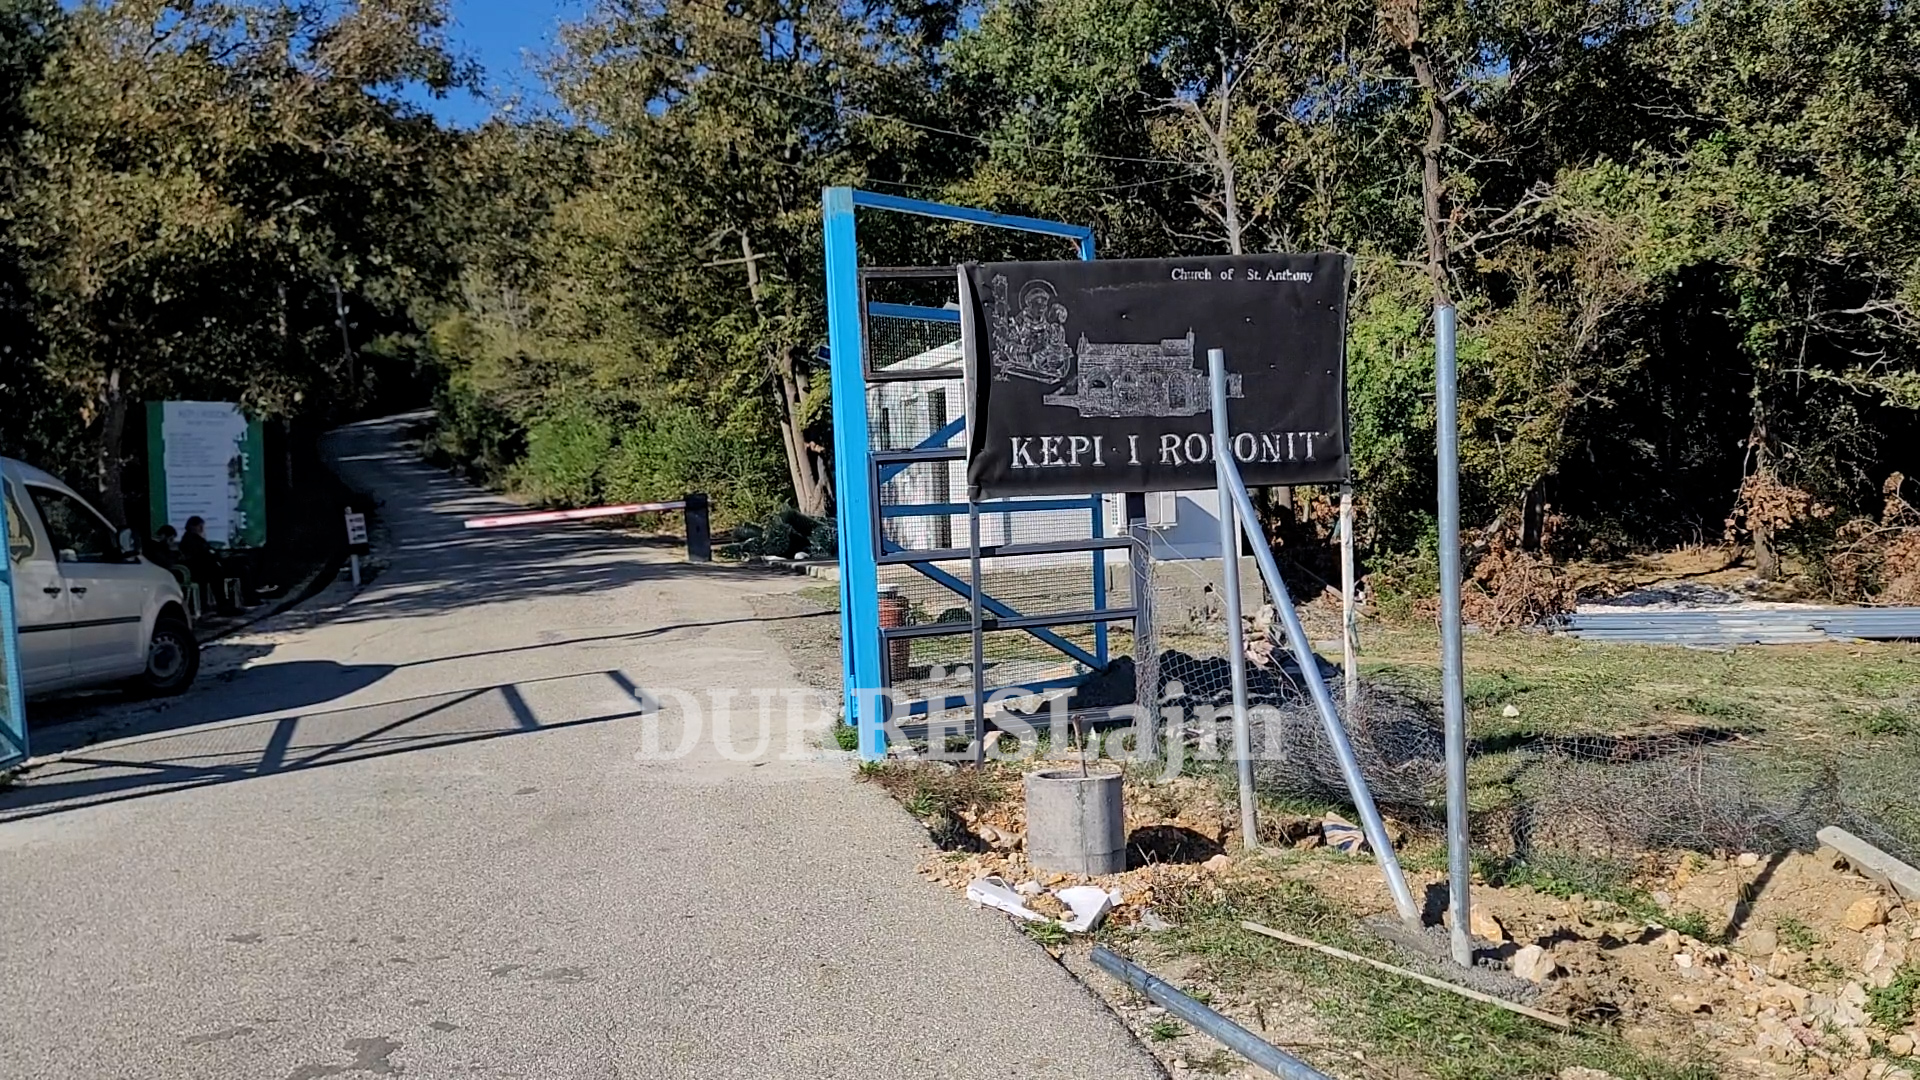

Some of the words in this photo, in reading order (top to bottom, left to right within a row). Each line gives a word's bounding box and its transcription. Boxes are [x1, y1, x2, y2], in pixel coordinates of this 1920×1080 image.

[1170, 267, 1212, 281] Church
[1219, 267, 1235, 281] of
[1246, 268, 1262, 281] St.
[1265, 268, 1314, 284] Anthony
[1008, 434, 1105, 469] KEPI
[1127, 433, 1142, 465] I
